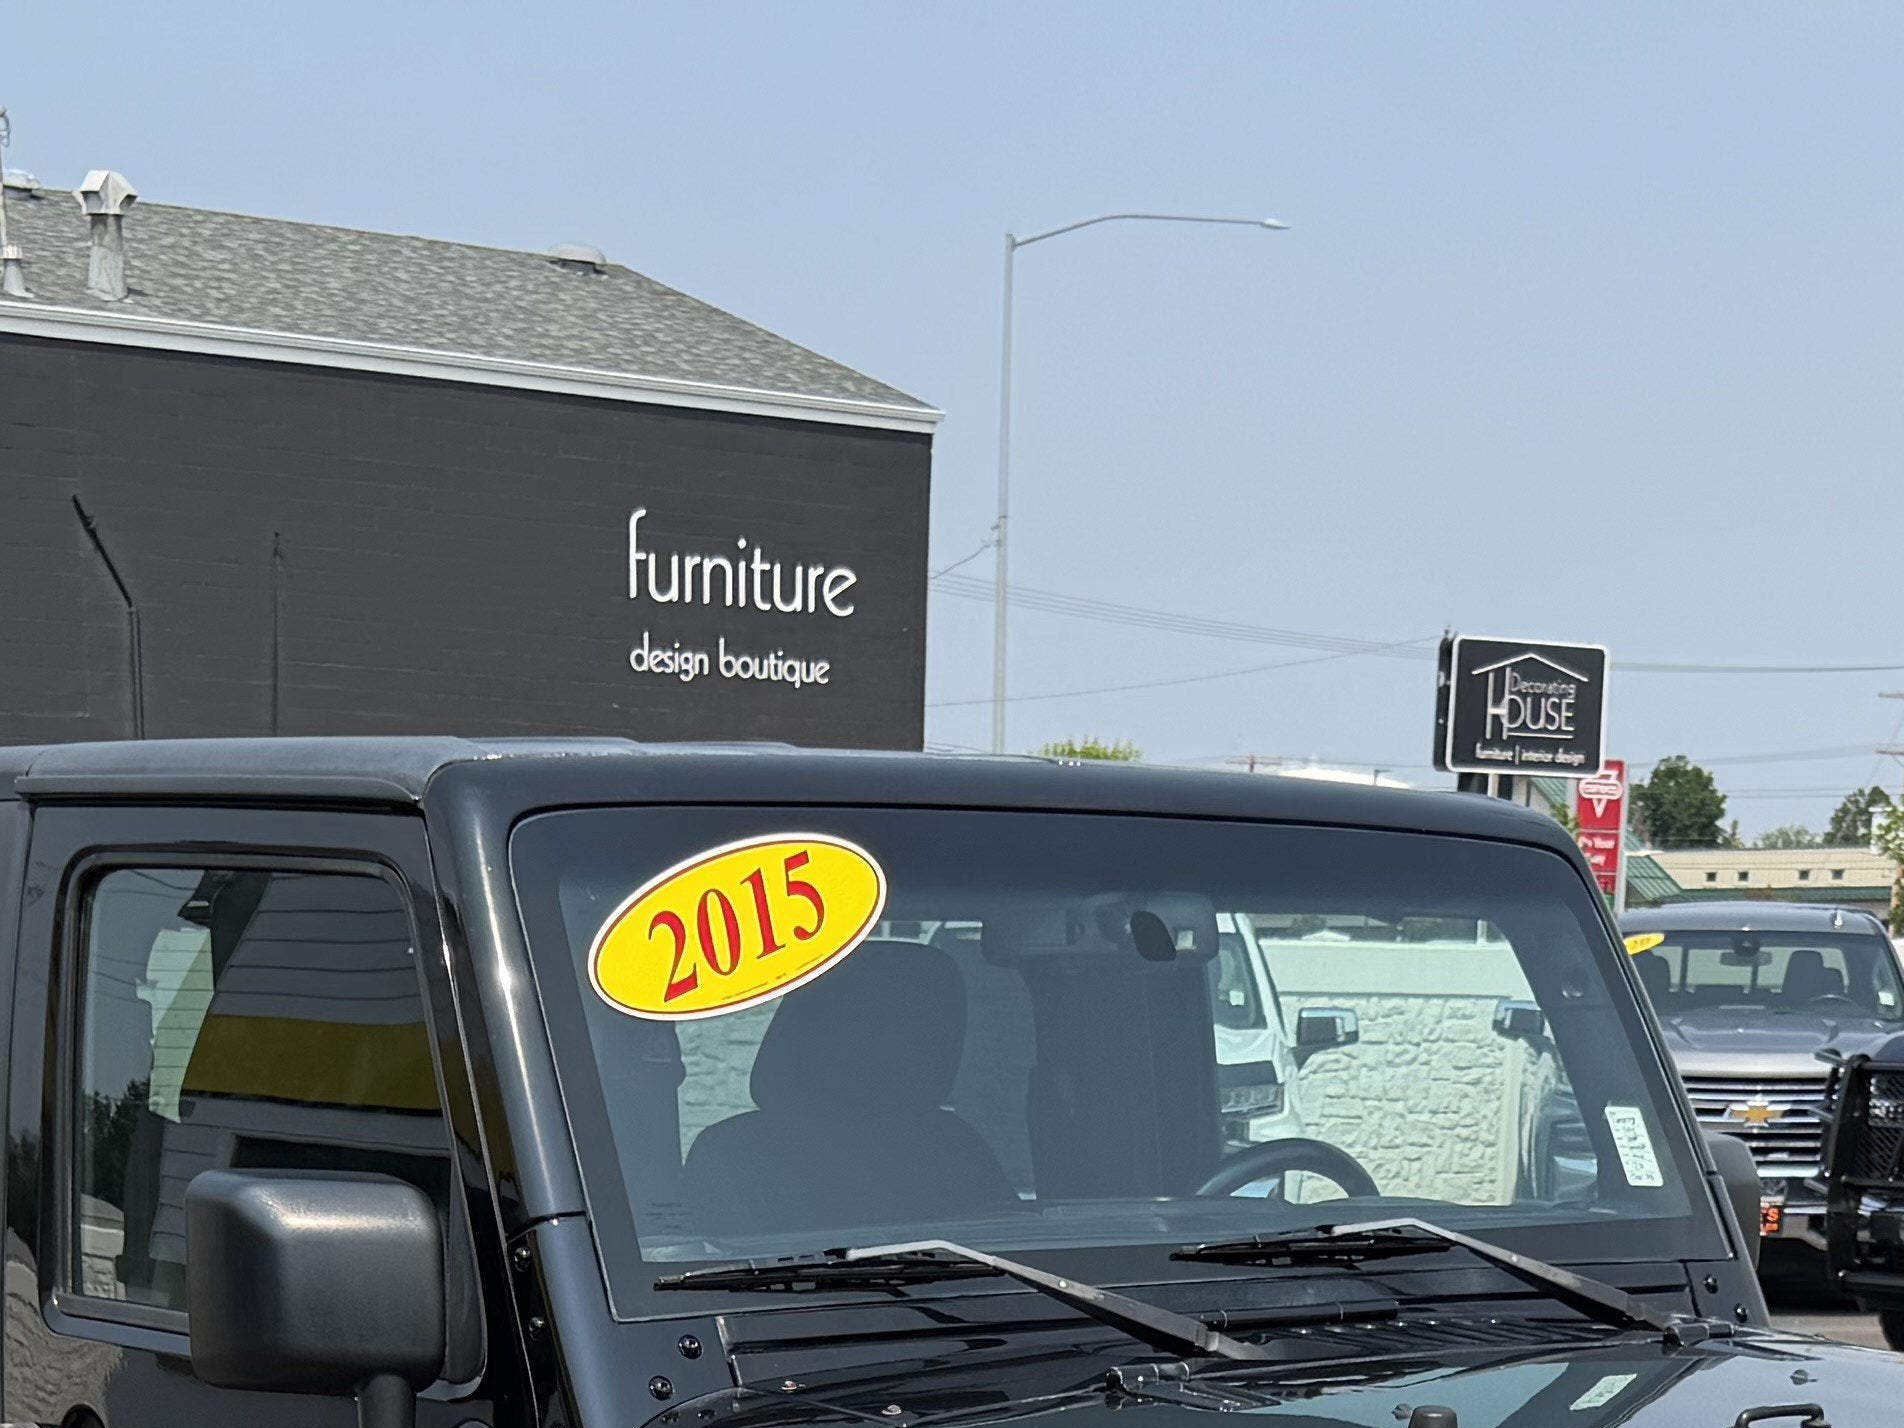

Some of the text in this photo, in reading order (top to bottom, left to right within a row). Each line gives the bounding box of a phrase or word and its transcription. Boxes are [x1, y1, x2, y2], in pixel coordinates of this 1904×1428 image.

[628, 508, 857, 617] furniture
[629, 630, 830, 689] design boutique
[1509, 672, 1576, 699] Decorating
[1485, 666, 1575, 740] HOUSE
[647, 849, 825, 1003] 2015
